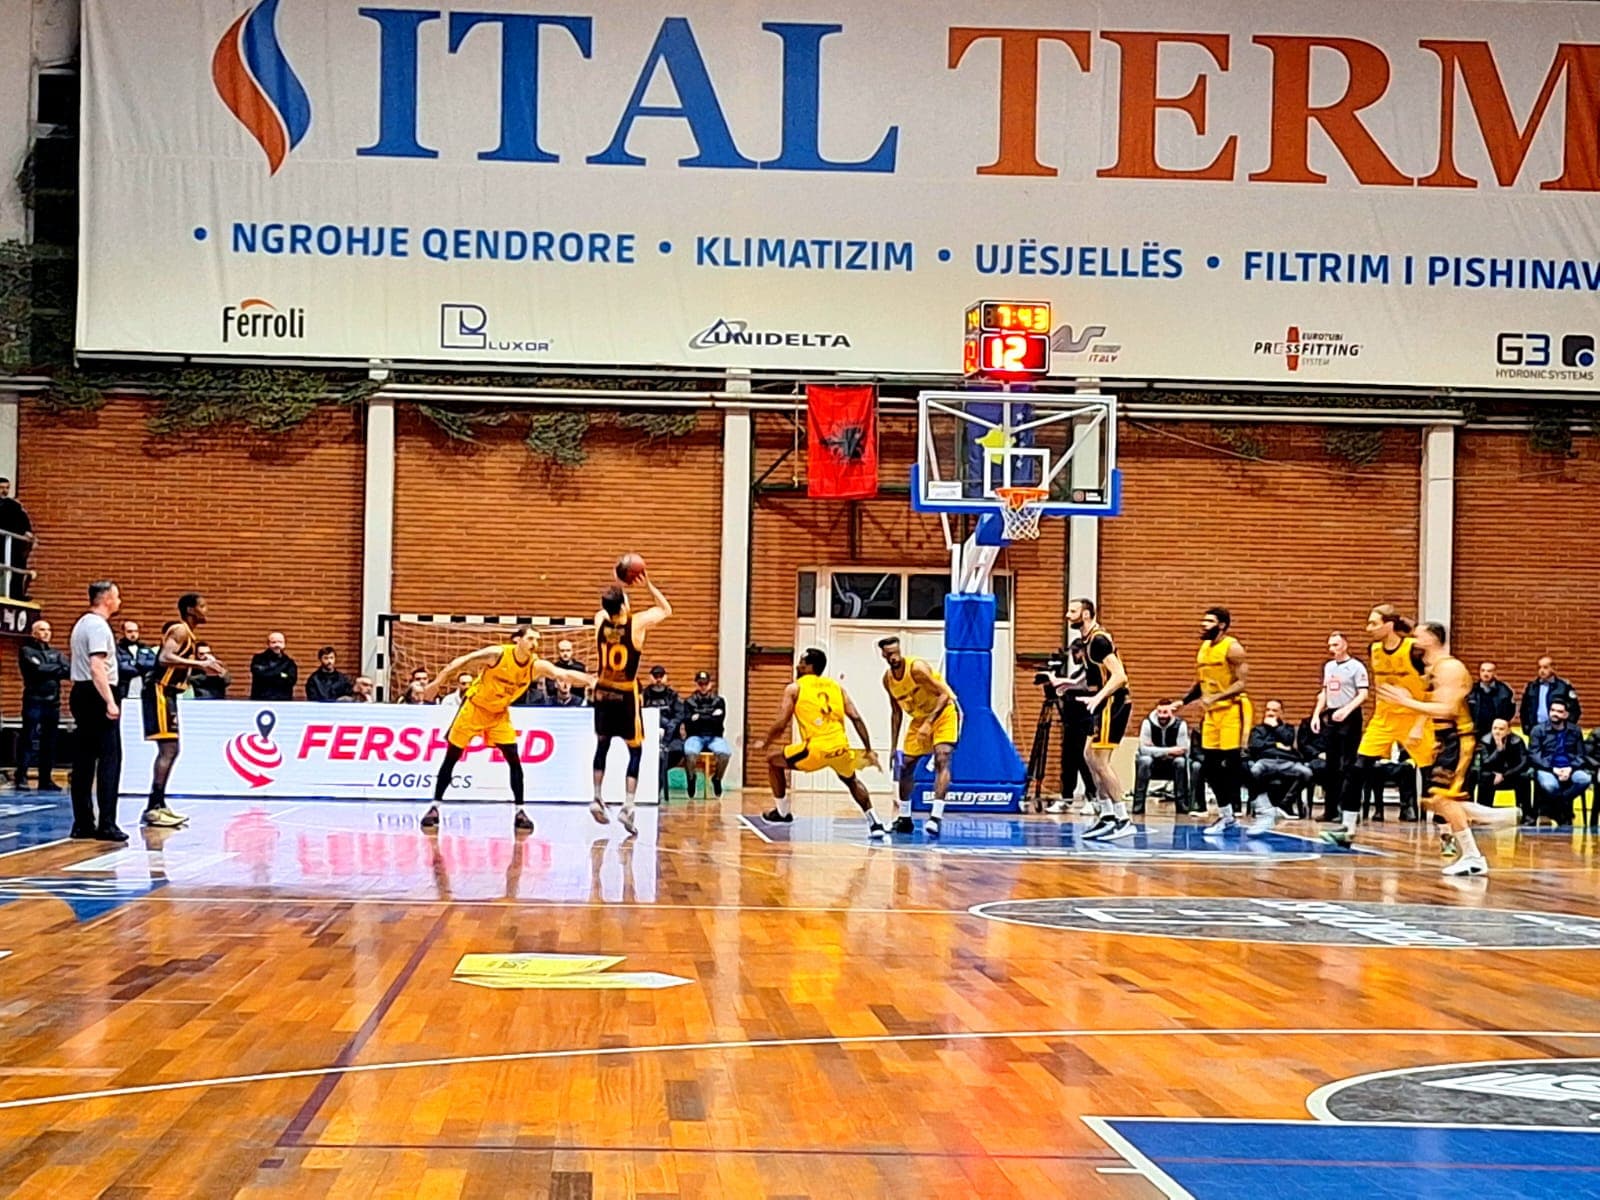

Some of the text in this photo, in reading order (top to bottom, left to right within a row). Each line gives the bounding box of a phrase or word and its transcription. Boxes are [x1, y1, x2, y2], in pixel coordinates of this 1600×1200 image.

[356, 7, 1600, 192] ITAL TERM
[231, 222, 635, 264] NGROHJE QENDRORE
[696, 236, 914, 271] KLIMATIZIM
[976, 238, 1184, 279] UJËSJELLËS
[1244, 251, 1600, 291] FILTRIM I PISHINAV
[223, 306, 304, 343] Ferroli
[997, 306, 1048, 330] 7:43
[488, 341, 549, 351] LUXOR
[713, 331, 851, 348] UNIDELTA
[991, 336, 1027, 371] 12
[1253, 341, 1360, 357] PRESSFITTING
[1496, 332, 1551, 366] G3
[1495, 368, 1595, 381] HYDRONIC SYSTEMS
[601, 642, 629, 672] 10
[377, 772, 473, 789] LOGISCS
